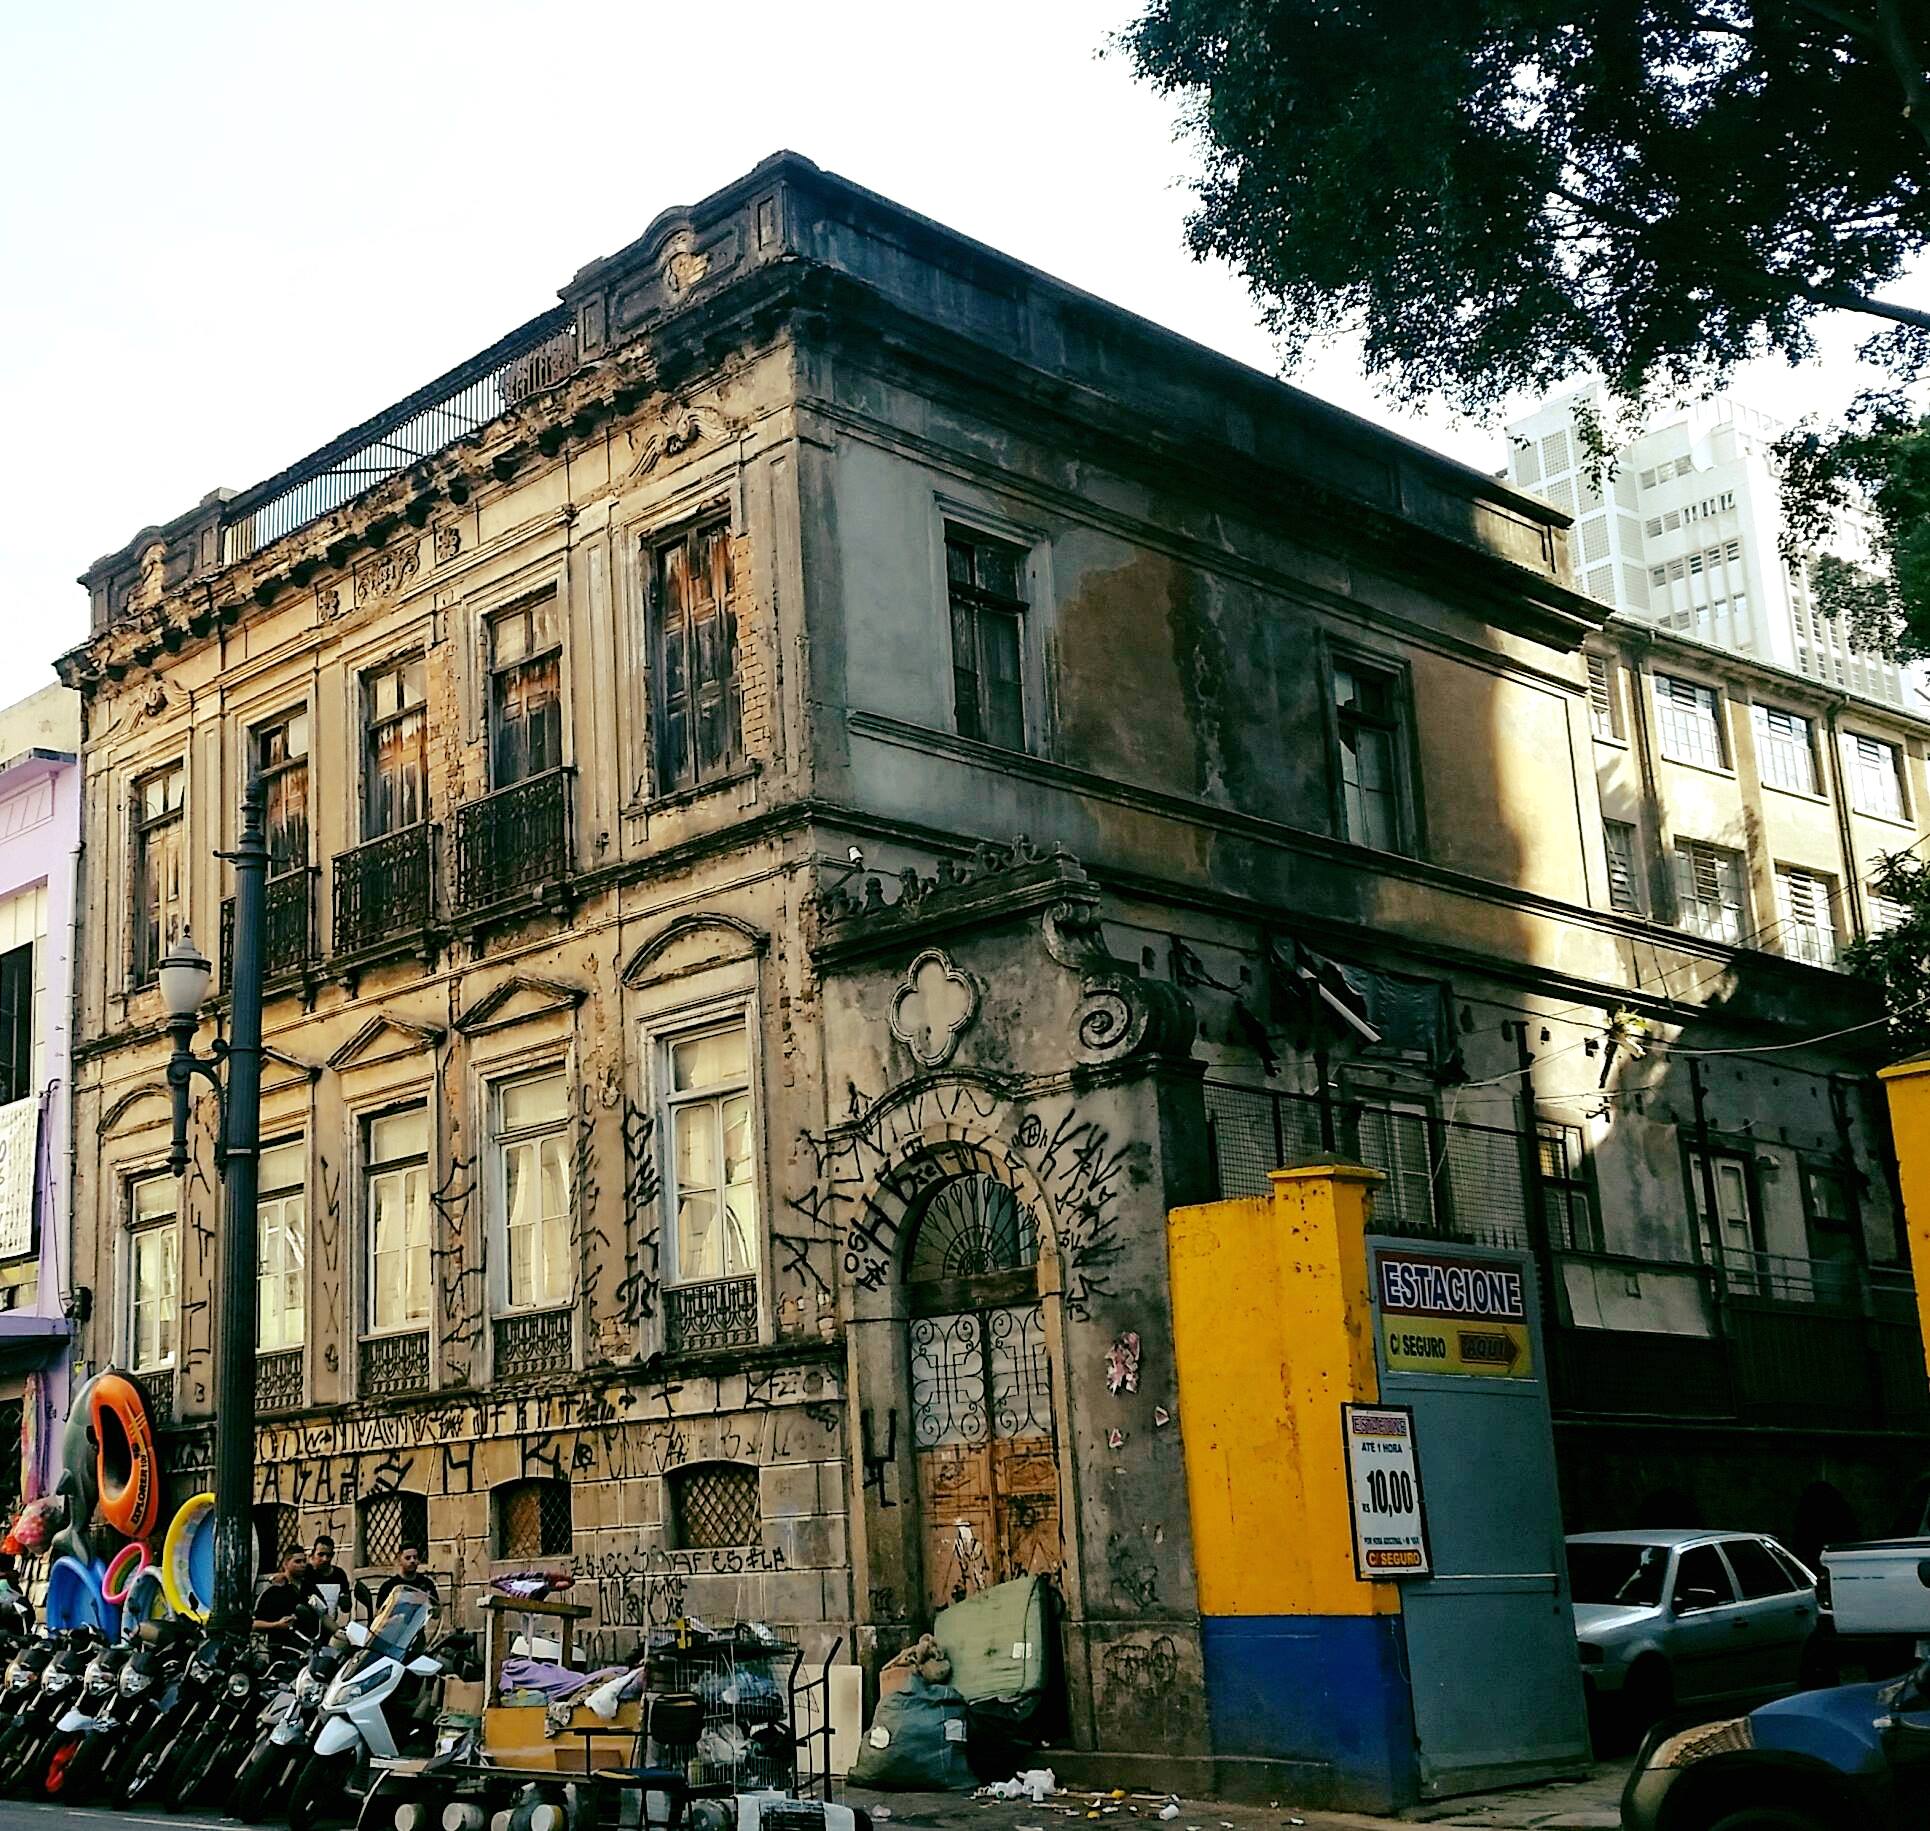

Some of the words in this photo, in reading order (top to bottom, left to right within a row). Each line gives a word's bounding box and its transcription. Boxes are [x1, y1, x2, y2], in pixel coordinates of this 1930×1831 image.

[1382, 1261, 1524, 1316] ESTACIONE
[1402, 1334, 1446, 1359] SEGURO
[1383, 1443, 1403, 1453] HORA
[1366, 1469, 1414, 1517] 10,00
[1380, 1552, 1420, 1566] SEGURO
